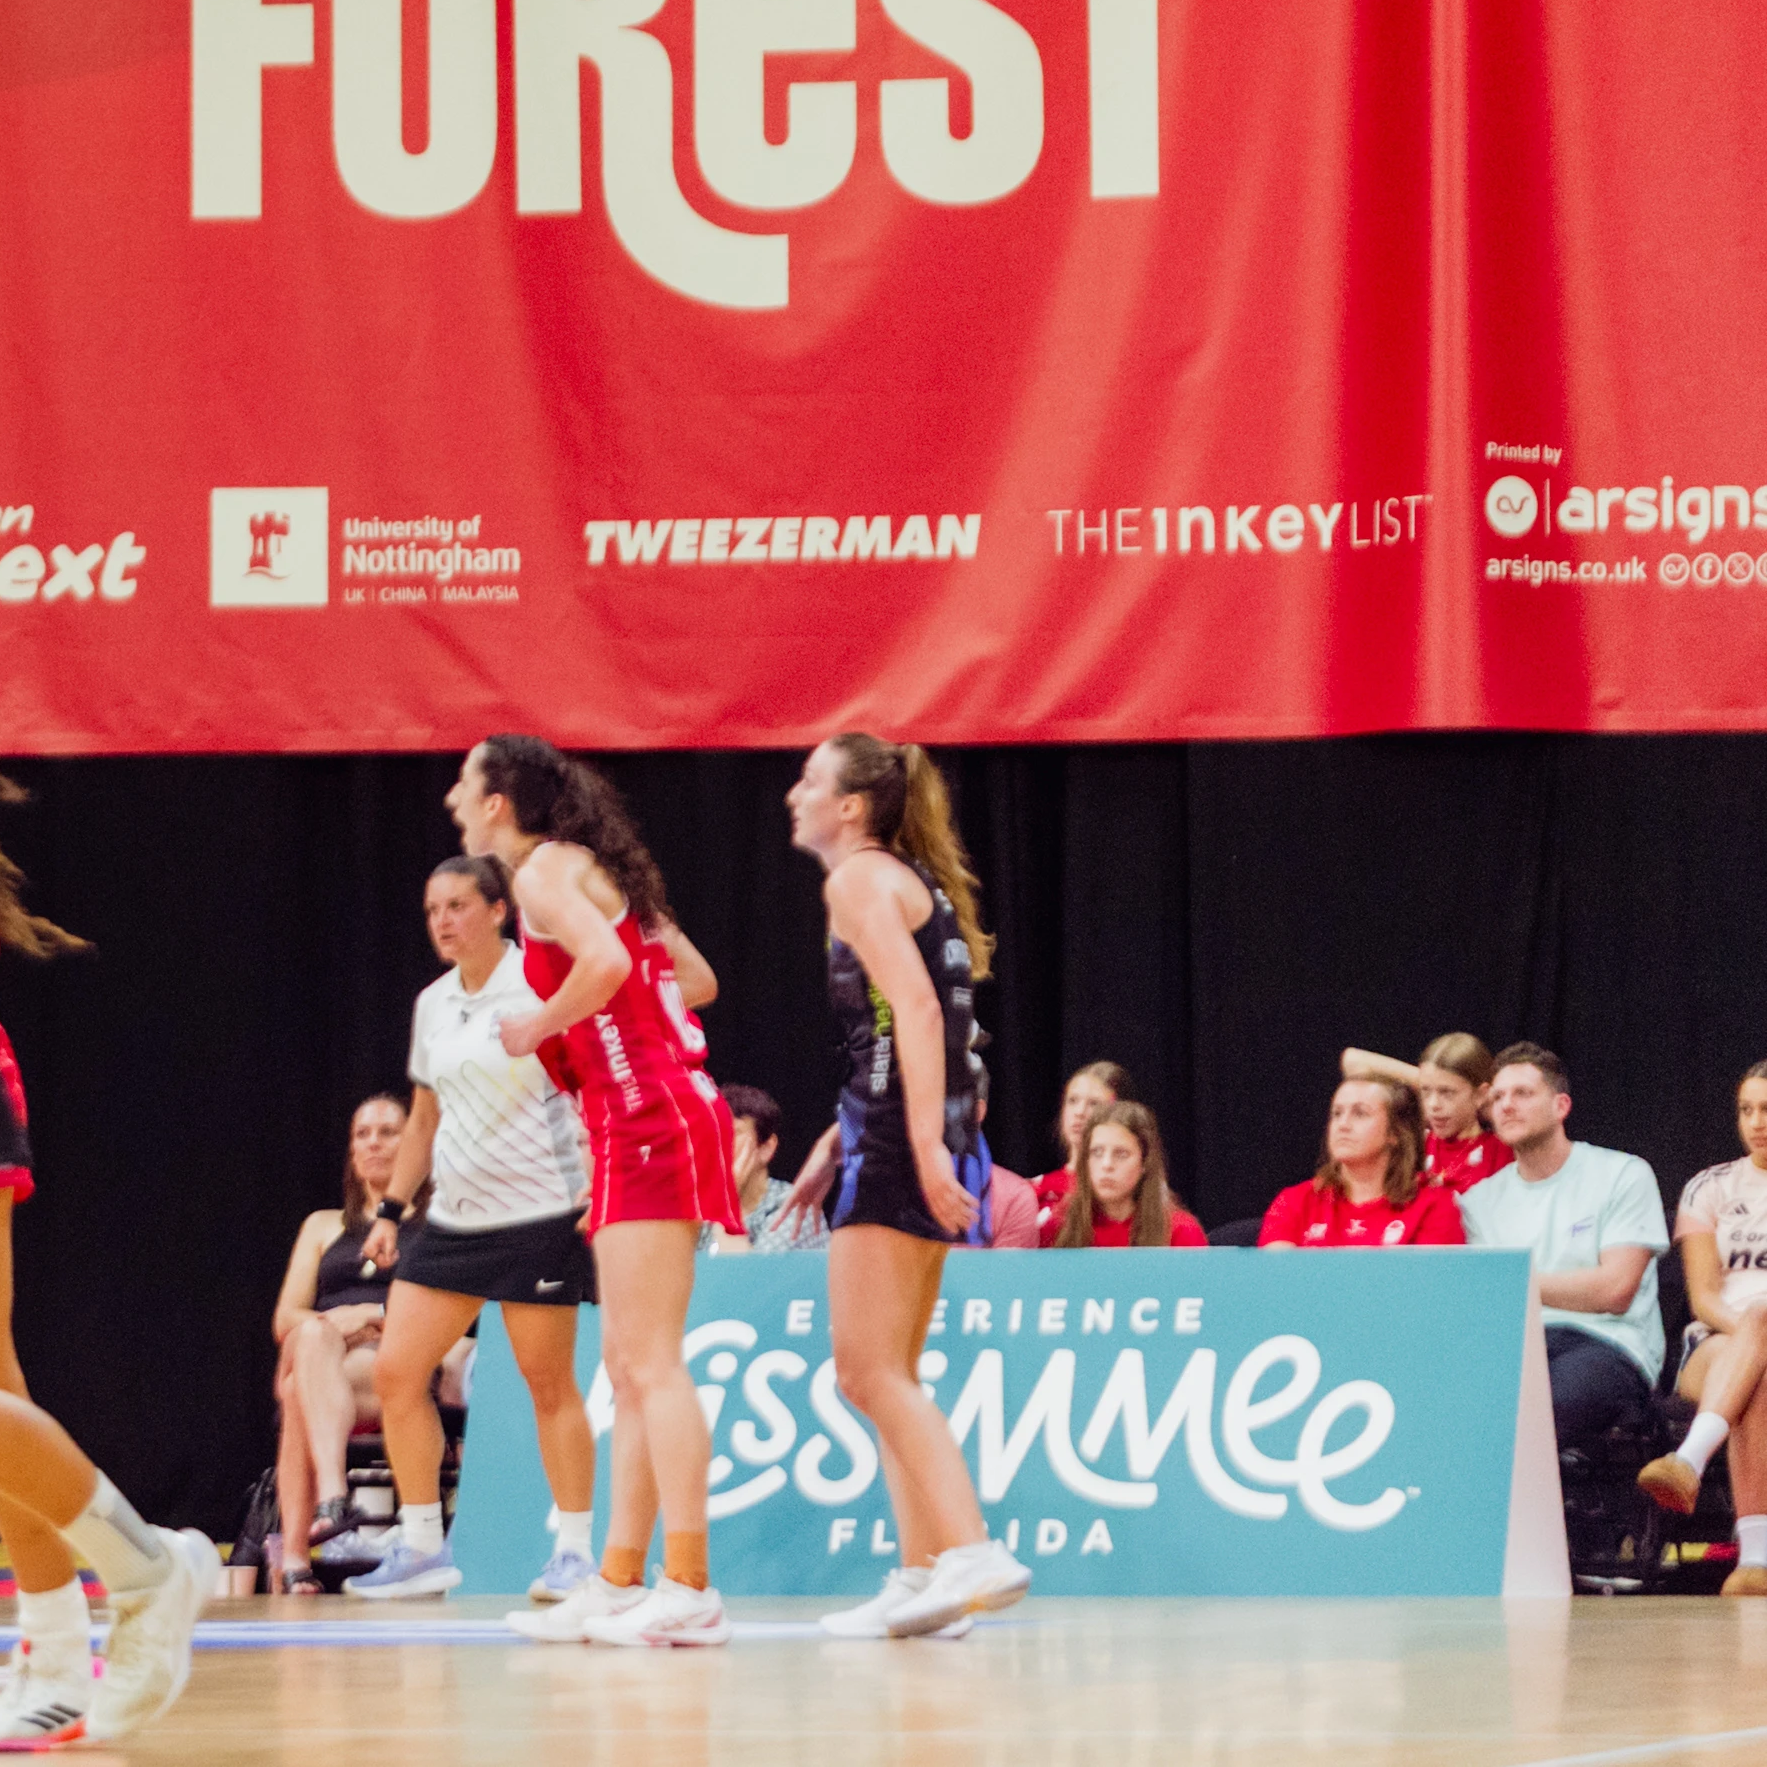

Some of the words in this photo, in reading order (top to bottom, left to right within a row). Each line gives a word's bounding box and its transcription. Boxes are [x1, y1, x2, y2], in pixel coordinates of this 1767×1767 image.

[1485, 441, 1540, 463] Printed
[1543, 444, 1562, 467] by
[343, 515, 454, 543] University
[457, 514, 482, 539] of
[585, 513, 982, 565] TWEEZERMAN
[1047, 507, 1143, 554] THE
[1347, 494, 1428, 549] LIST
[343, 540, 522, 583] Nottingham
[1485, 553, 1647, 587] arsigns.co.uk
[344, 587, 366, 603] UK
[380, 585, 427, 602] CHINA
[441, 584, 520, 601] MALAYSIA
[828, 1519, 1114, 1555] FLIDA
